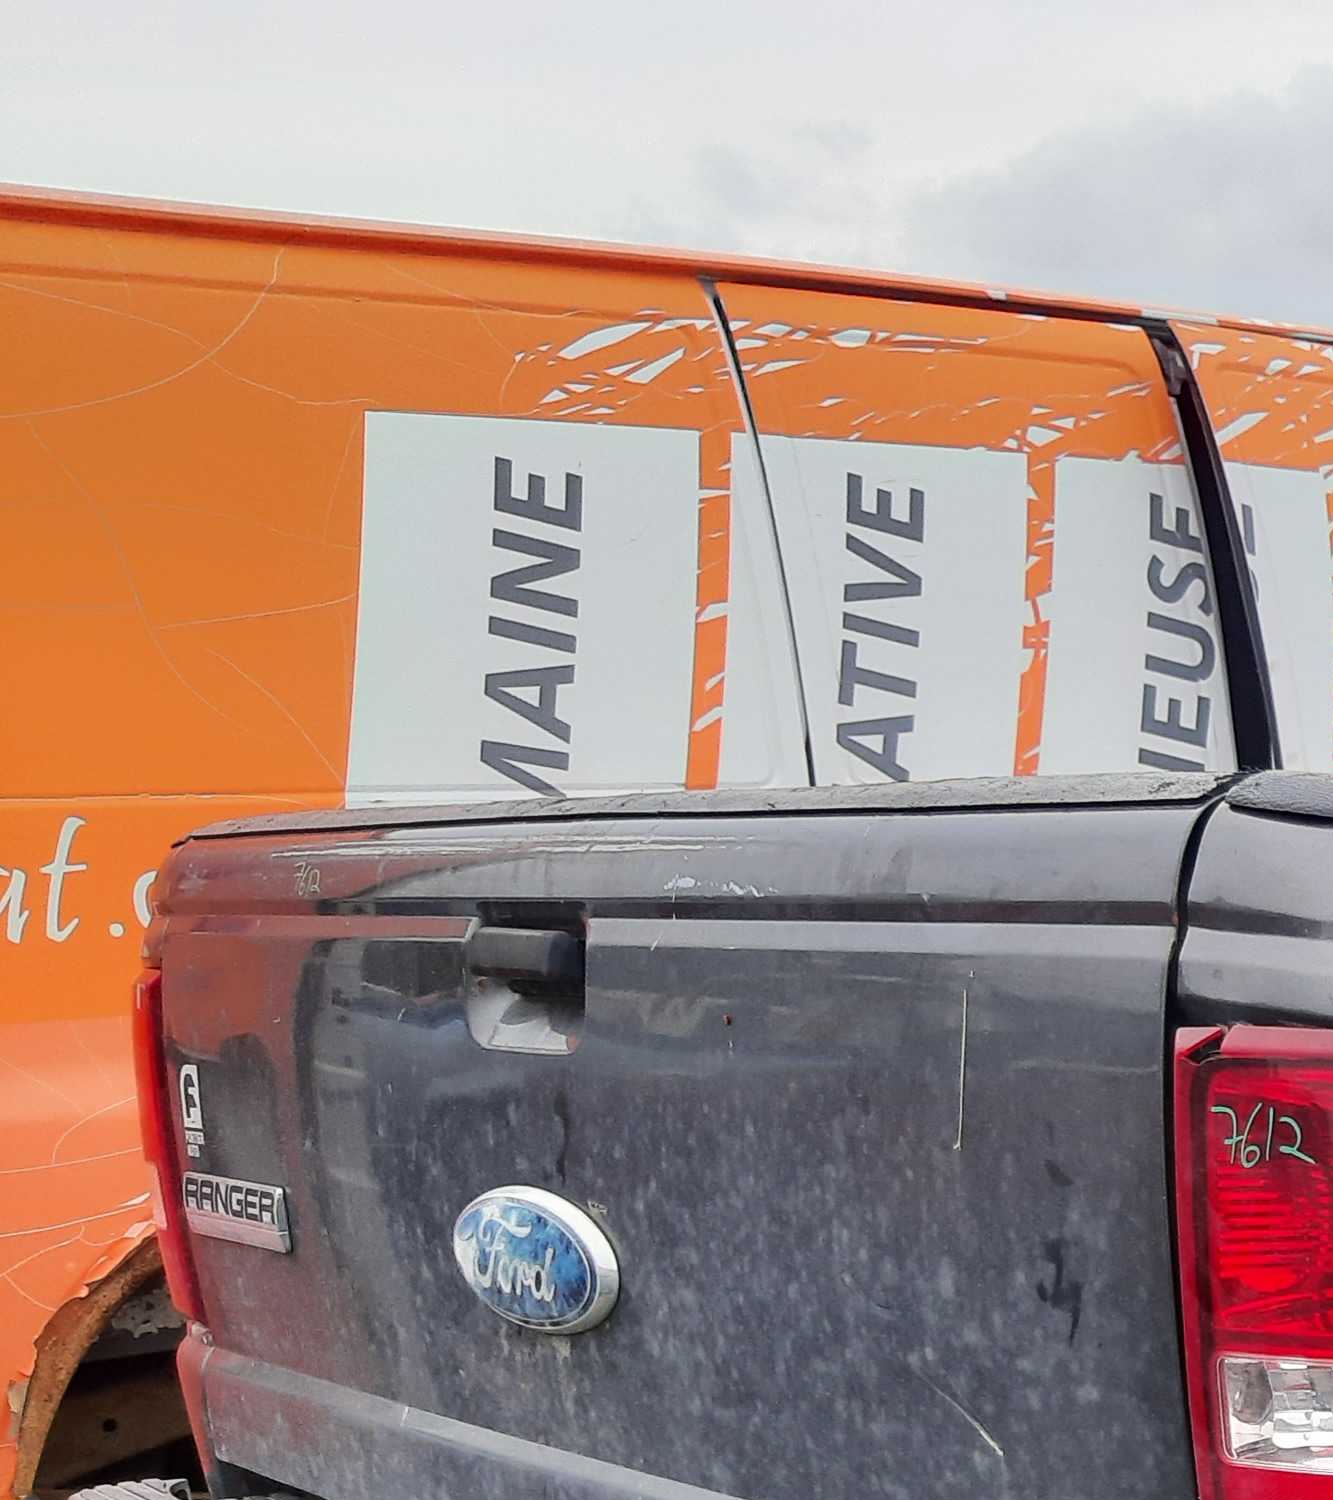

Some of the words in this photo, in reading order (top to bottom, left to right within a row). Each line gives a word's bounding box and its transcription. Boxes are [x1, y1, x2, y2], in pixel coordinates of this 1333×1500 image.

[836, 472, 925, 782] ATIVE
[1210, 1102, 1317, 1168] 7612
[184, 1176, 276, 1225] RANGER
[458, 1214, 556, 1302] Ford
